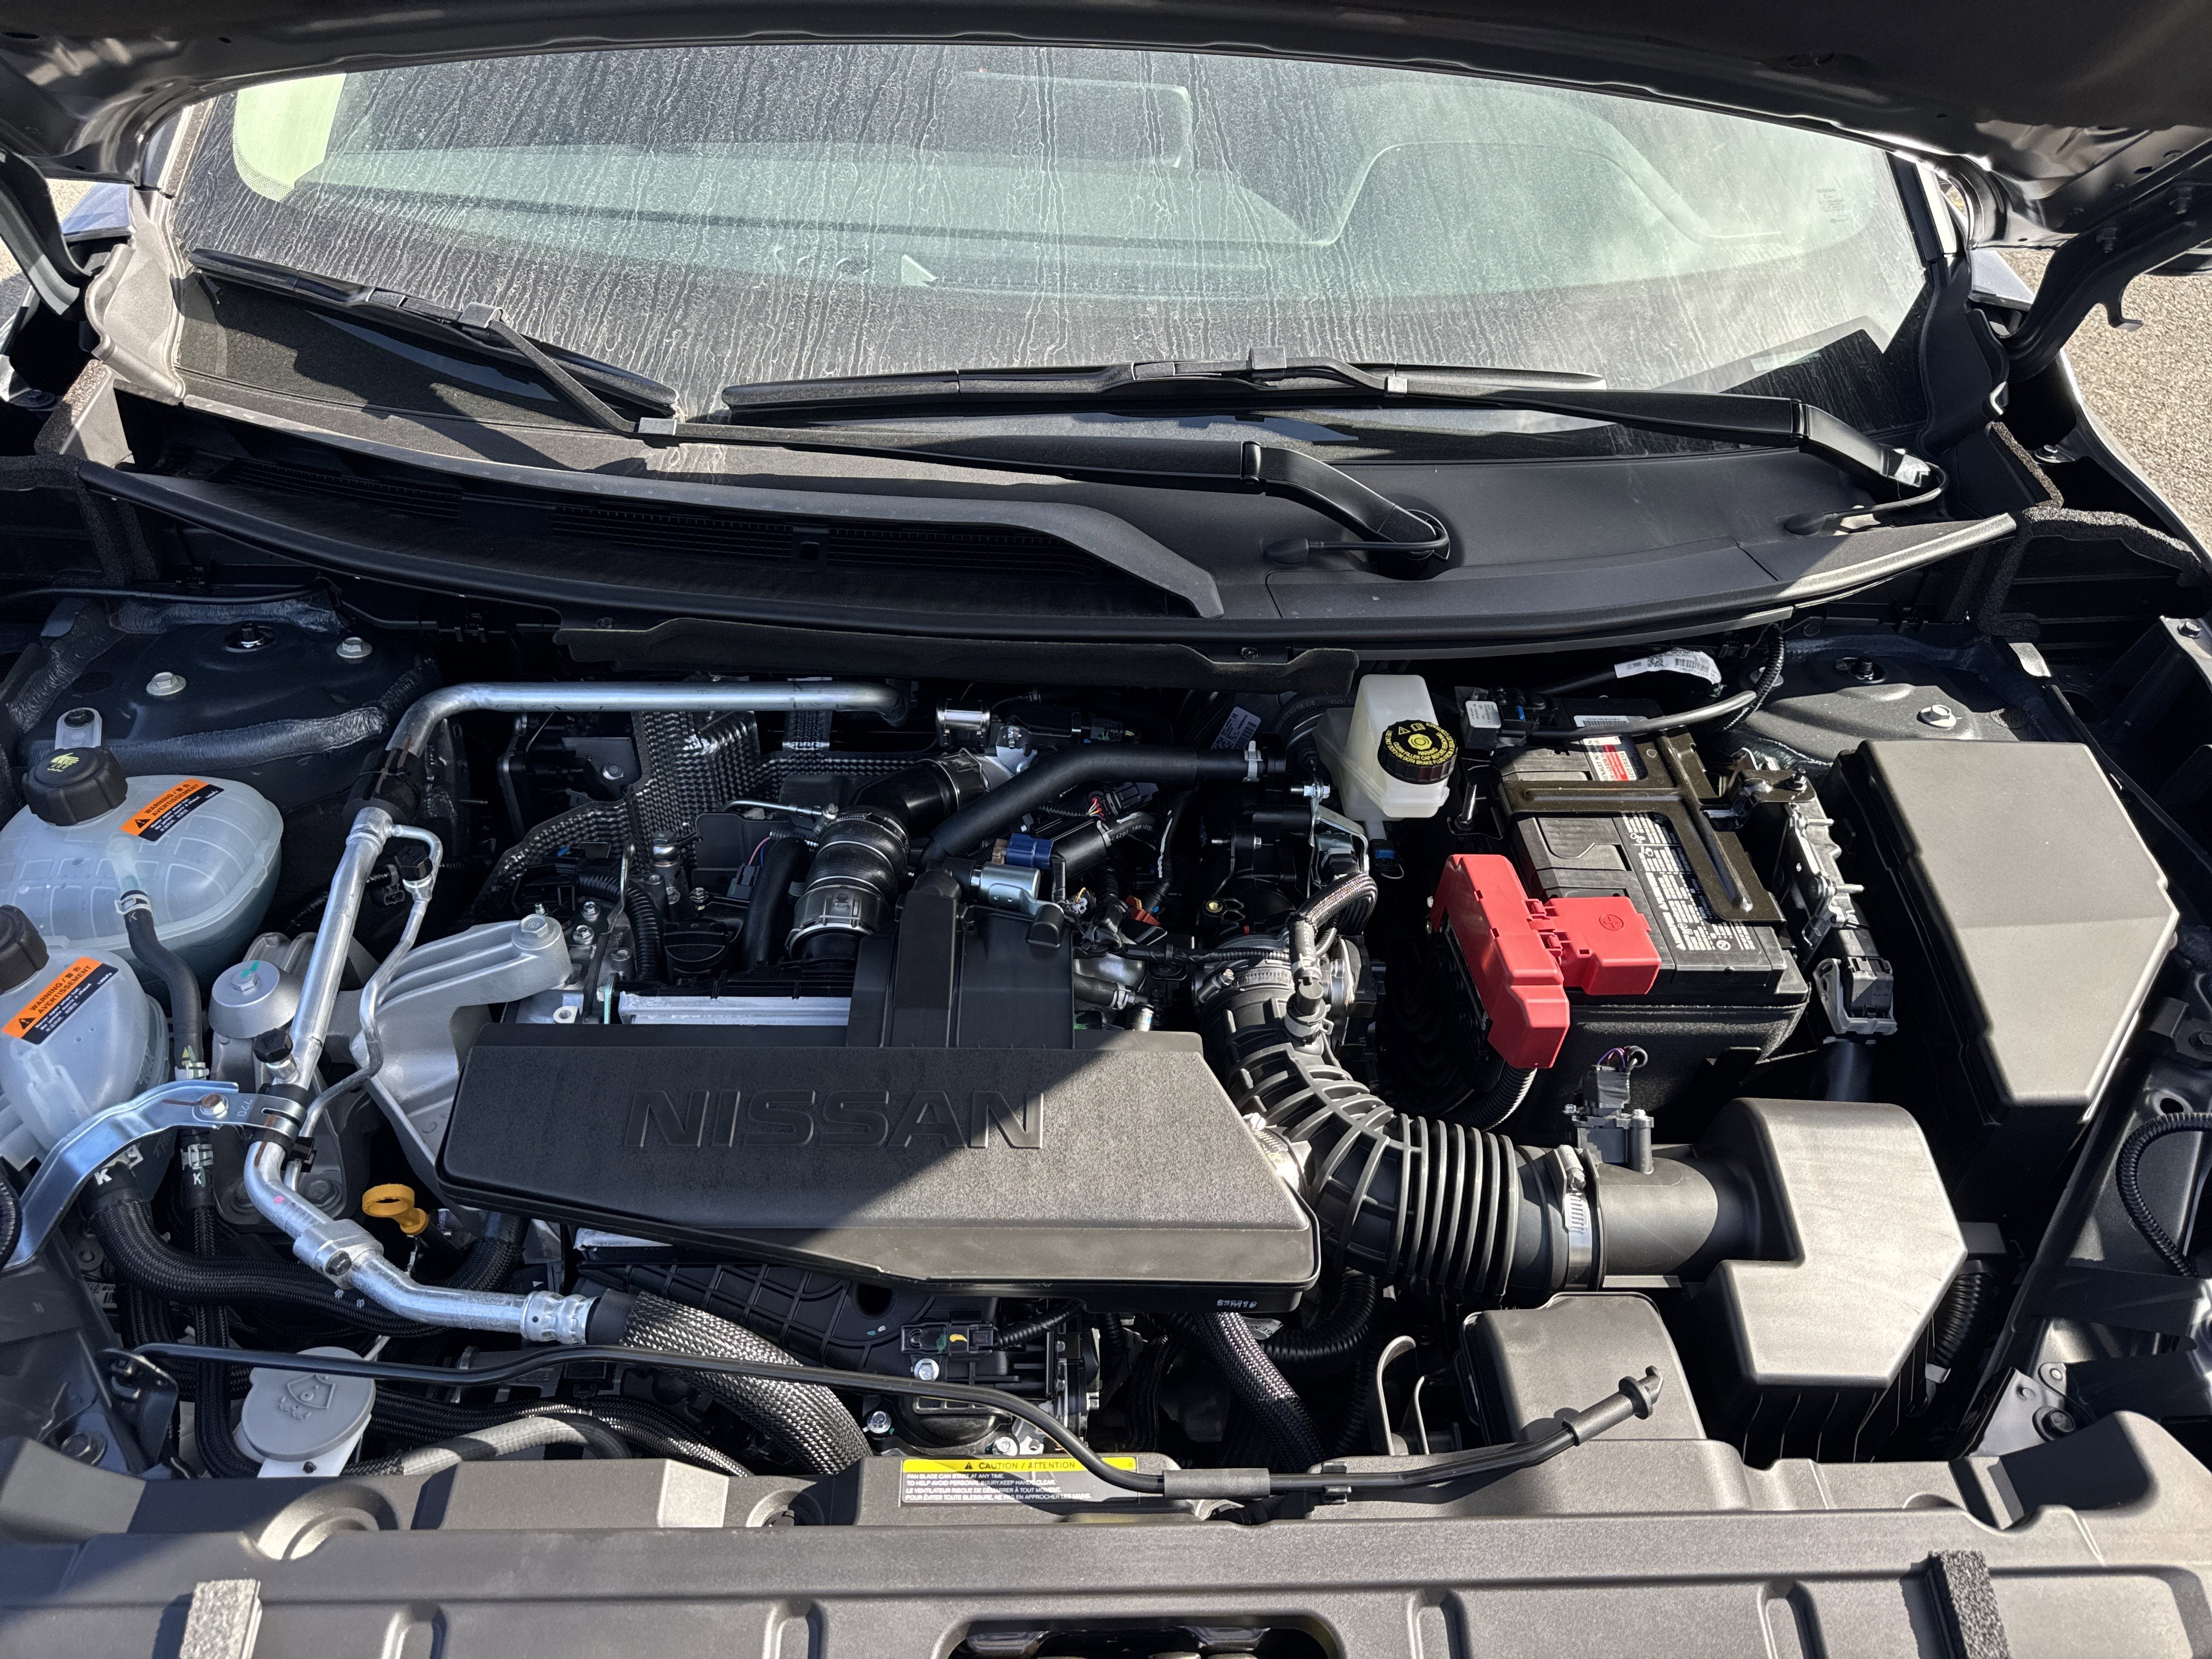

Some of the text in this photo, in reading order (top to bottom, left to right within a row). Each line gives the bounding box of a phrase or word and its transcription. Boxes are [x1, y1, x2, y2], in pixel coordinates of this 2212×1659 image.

[1403, 751, 1420, 760] FILLER
[1418, 747, 1438, 755] WARNING
[144, 793, 173, 814] WARNING
[152, 784, 200, 816] AVERTISSEMENT
[30, 983, 63, 1011] WARNING
[38, 966, 92, 1014] AVERTISSEMENT
[624, 1090, 1044, 1148] NISSAN
[94, 1169, 112, 1186] K
[193, 1172, 202, 1185] K
